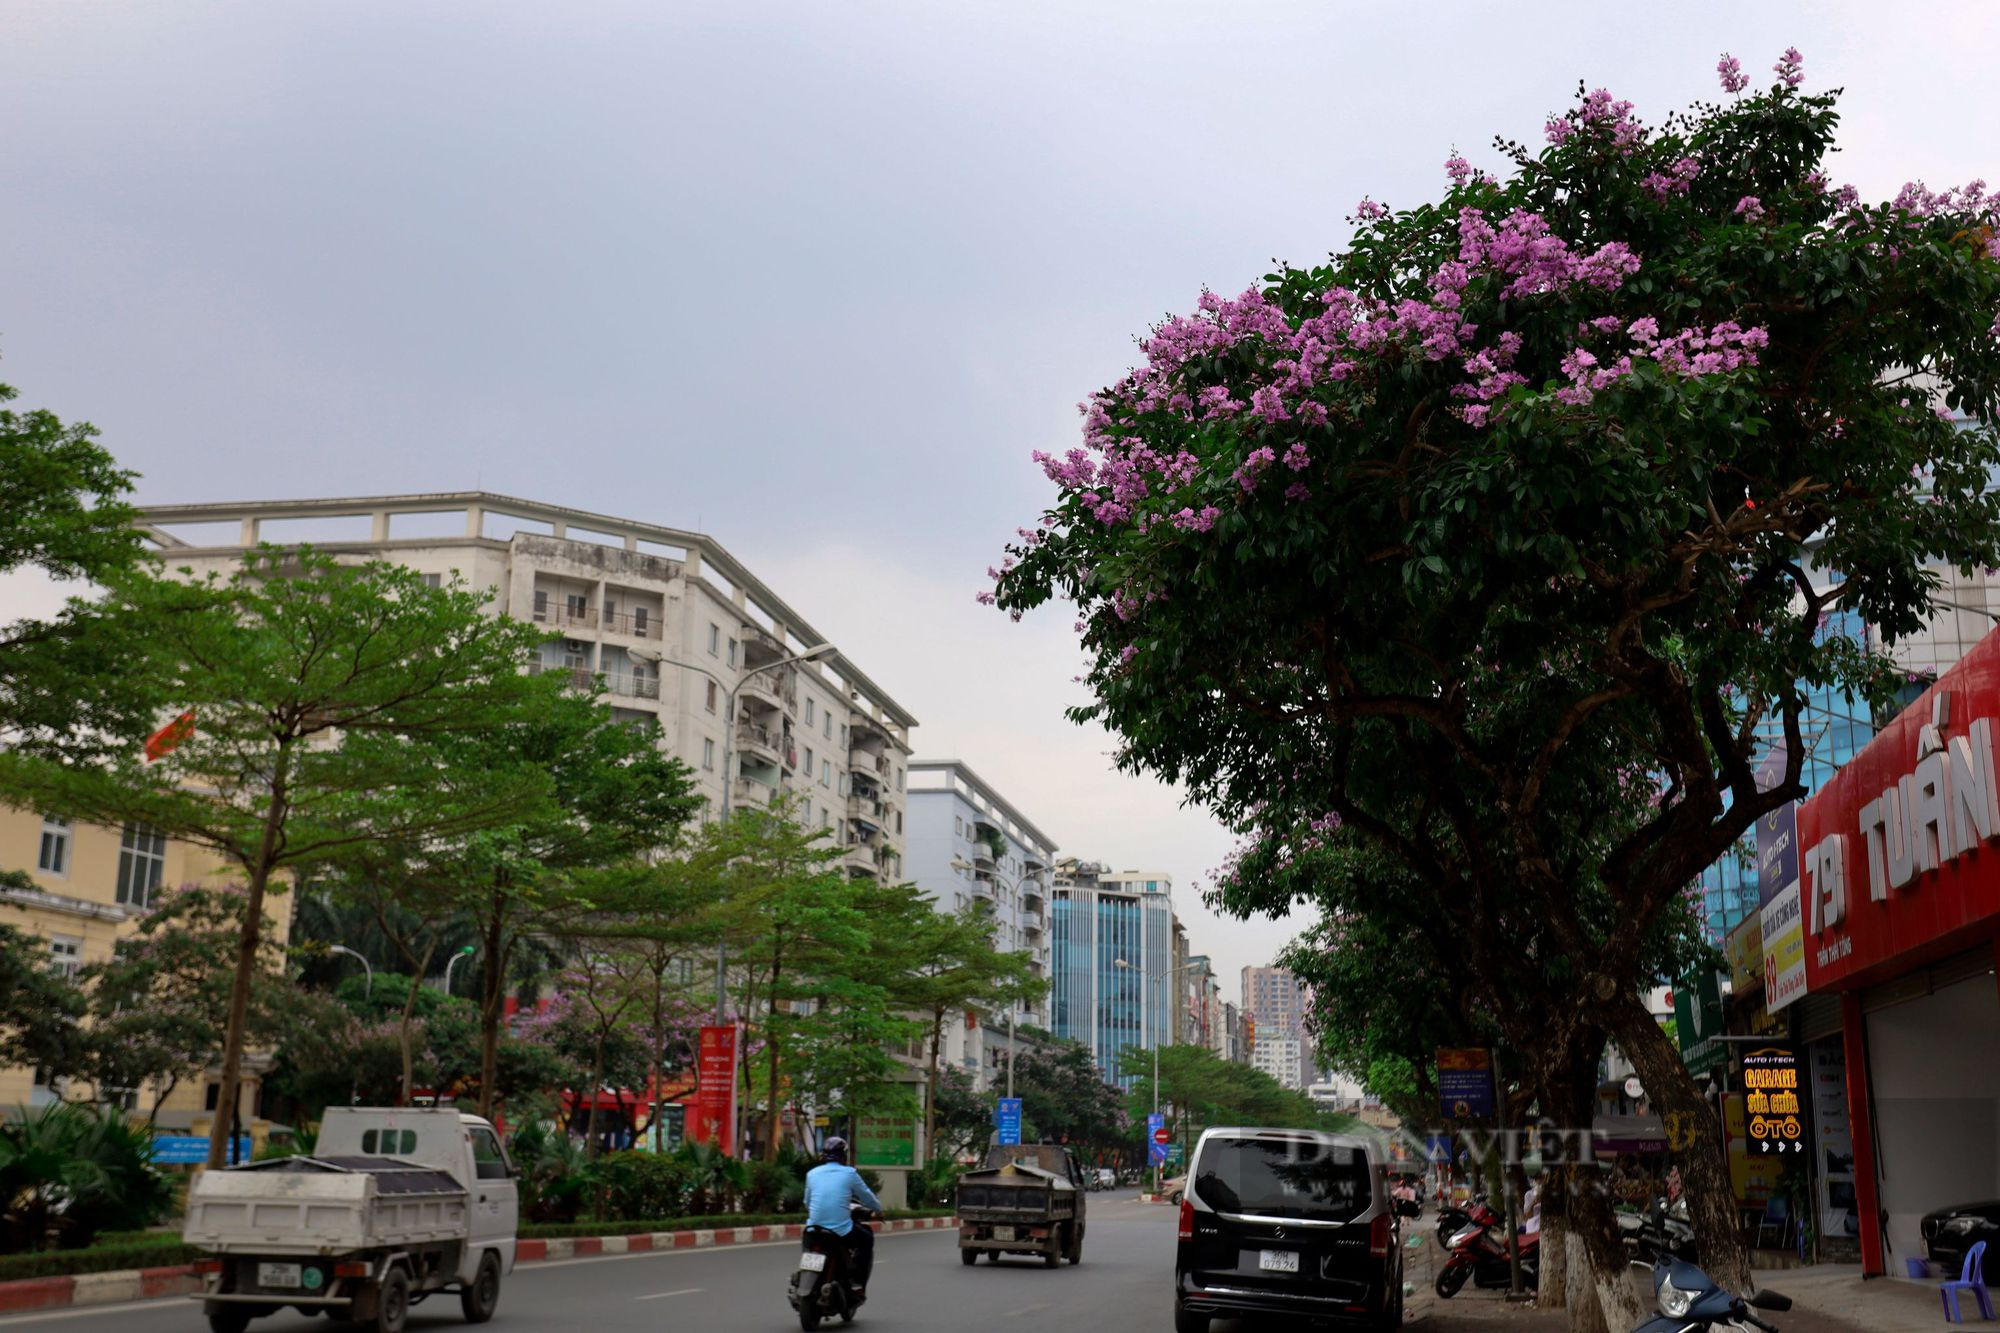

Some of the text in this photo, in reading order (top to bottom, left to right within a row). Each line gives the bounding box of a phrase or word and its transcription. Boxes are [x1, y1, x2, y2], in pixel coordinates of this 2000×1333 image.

[1805, 691, 2000, 937] 79 TUẤN
[1763, 847, 1774, 870] AUTO
[1765, 953, 1777, 1005] 89
[1745, 1068, 1797, 1088] GARAGE
[1747, 1089, 1799, 1113] SỬA CHỮA
[1750, 1115, 1800, 1139] ÔTÔ
